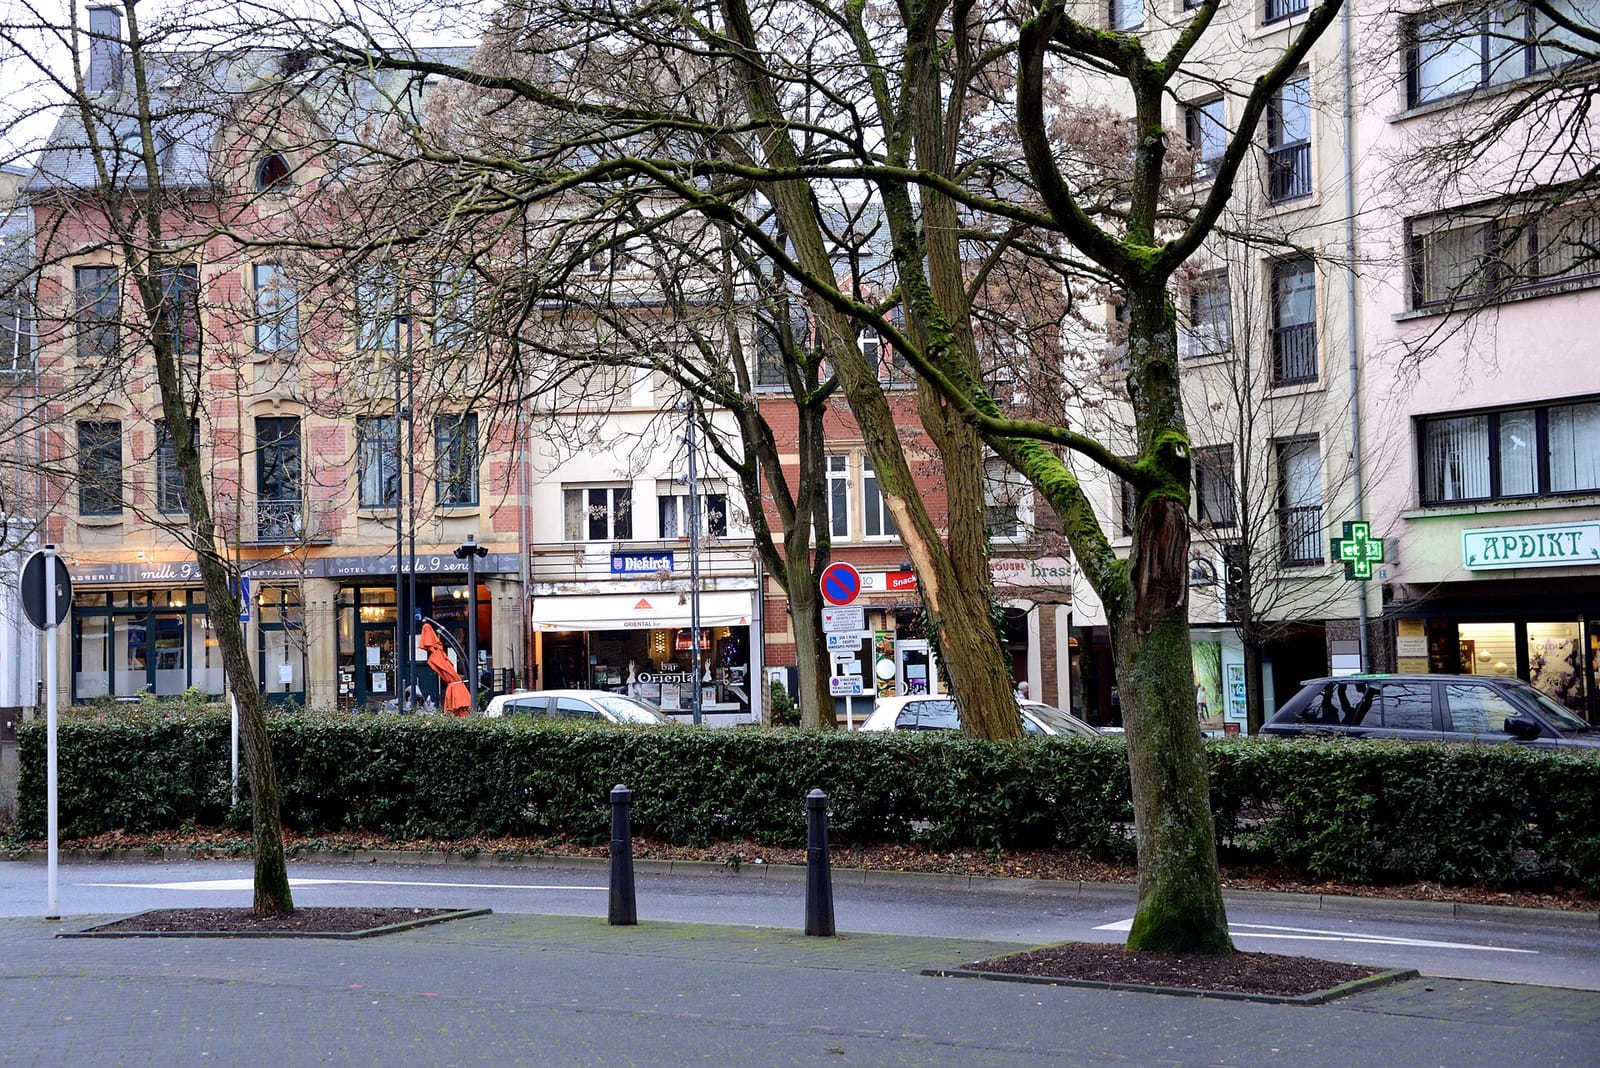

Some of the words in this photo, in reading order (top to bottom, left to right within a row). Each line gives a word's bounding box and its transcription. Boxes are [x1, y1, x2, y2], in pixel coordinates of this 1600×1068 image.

[1483, 532, 1583, 560] APDIKT
[430, 556, 441, 571] 9
[624, 555, 671, 571] Diekirch
[1030, 562, 1072, 577] brass
[70, 574, 116, 582] ASSERIE
[141, 564, 178, 579] mille
[180, 563, 192, 578] 9
[892, 575, 918, 588] Snack
[660, 662, 679, 672] bar
